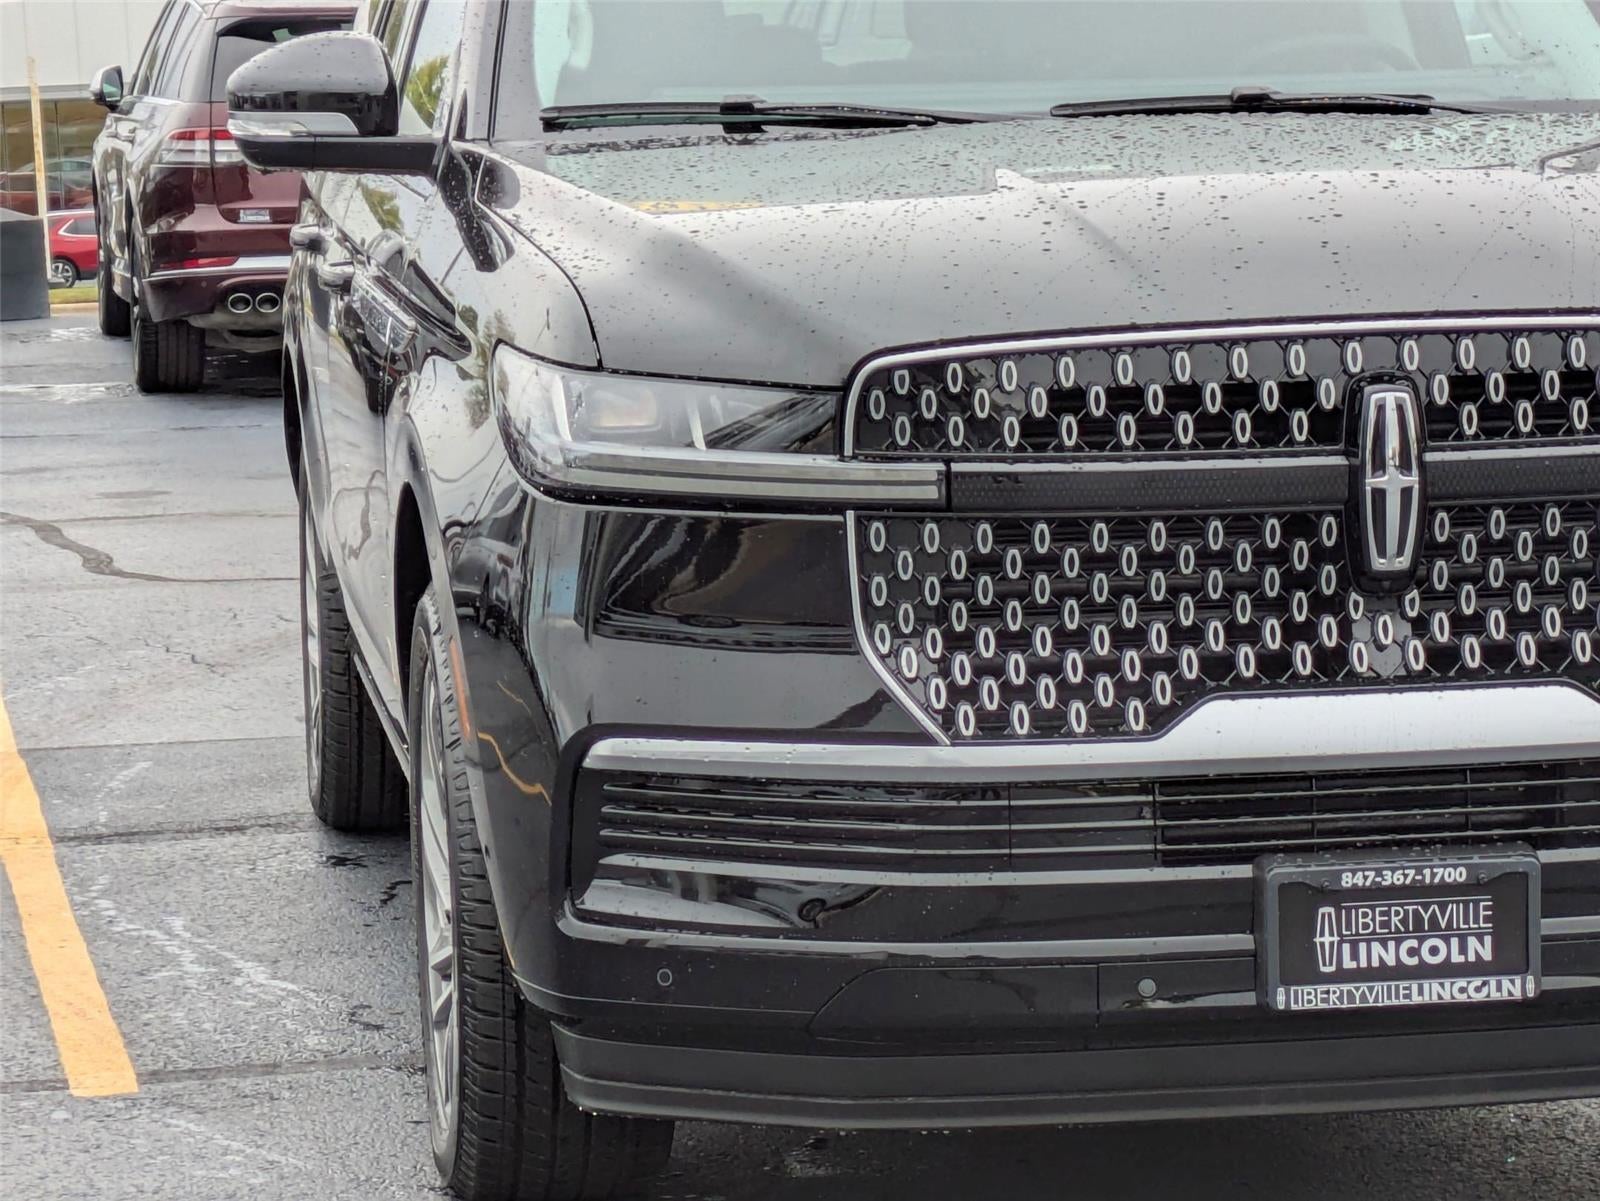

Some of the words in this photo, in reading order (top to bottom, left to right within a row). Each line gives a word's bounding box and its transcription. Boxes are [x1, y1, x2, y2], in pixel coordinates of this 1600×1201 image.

[1341, 867, 1467, 887] 847-367-1700
[1342, 902, 1493, 935] LIBERTYVILLE
[1342, 935, 1492, 969] LINCOLN
